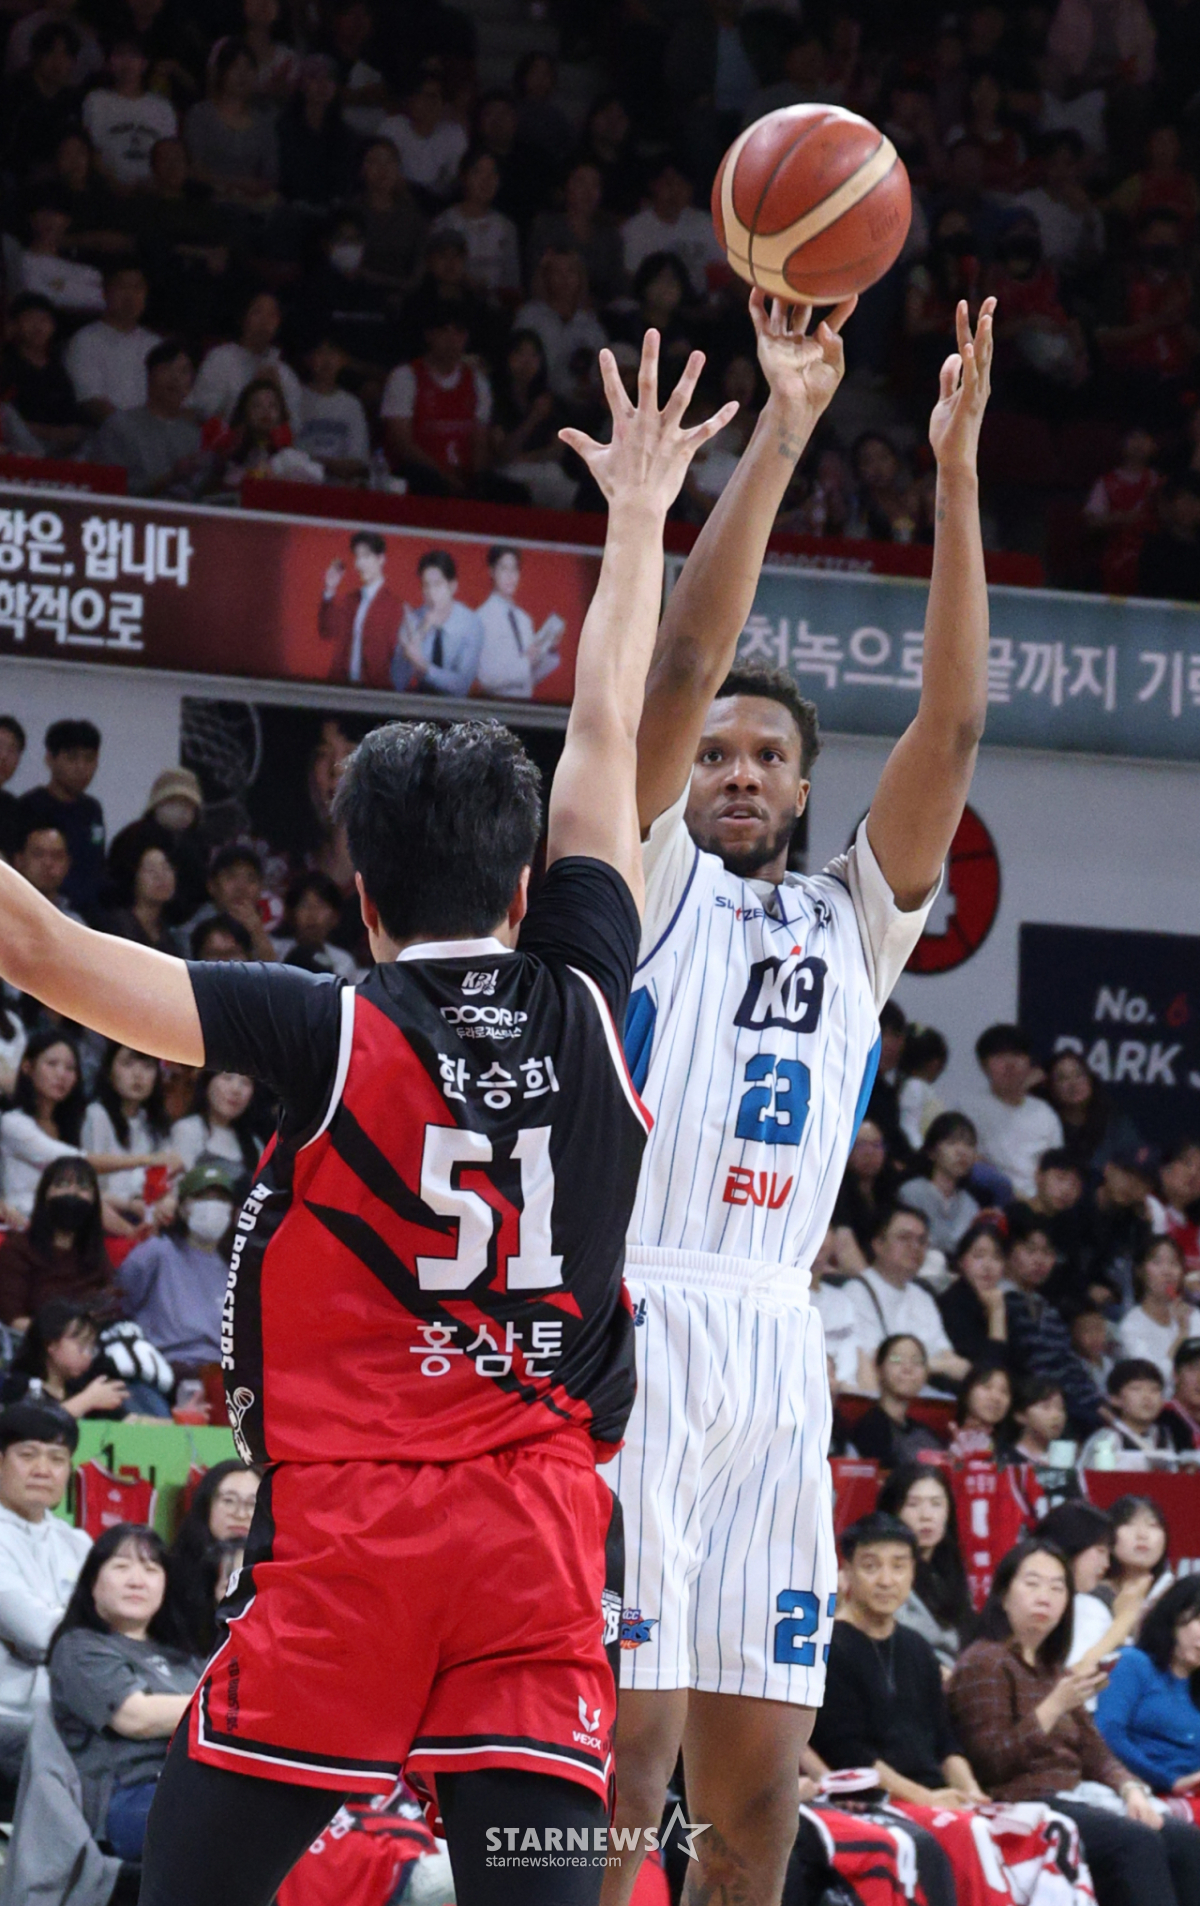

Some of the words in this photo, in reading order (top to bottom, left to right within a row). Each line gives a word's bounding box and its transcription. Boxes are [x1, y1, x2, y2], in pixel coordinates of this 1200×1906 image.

[81, 515, 194, 587] 합니다
[1094, 985, 1156, 1024] No.
[438, 1055, 560, 1110] 한승희
[734, 1053, 811, 1146] 23
[237, 1182, 273, 1231] RED
[416, 1123, 564, 1290] 51
[409, 1321, 563, 1377] 홍삼톤
[774, 1589, 837, 1667] 2
[572, 1730, 601, 1750] VEXX
